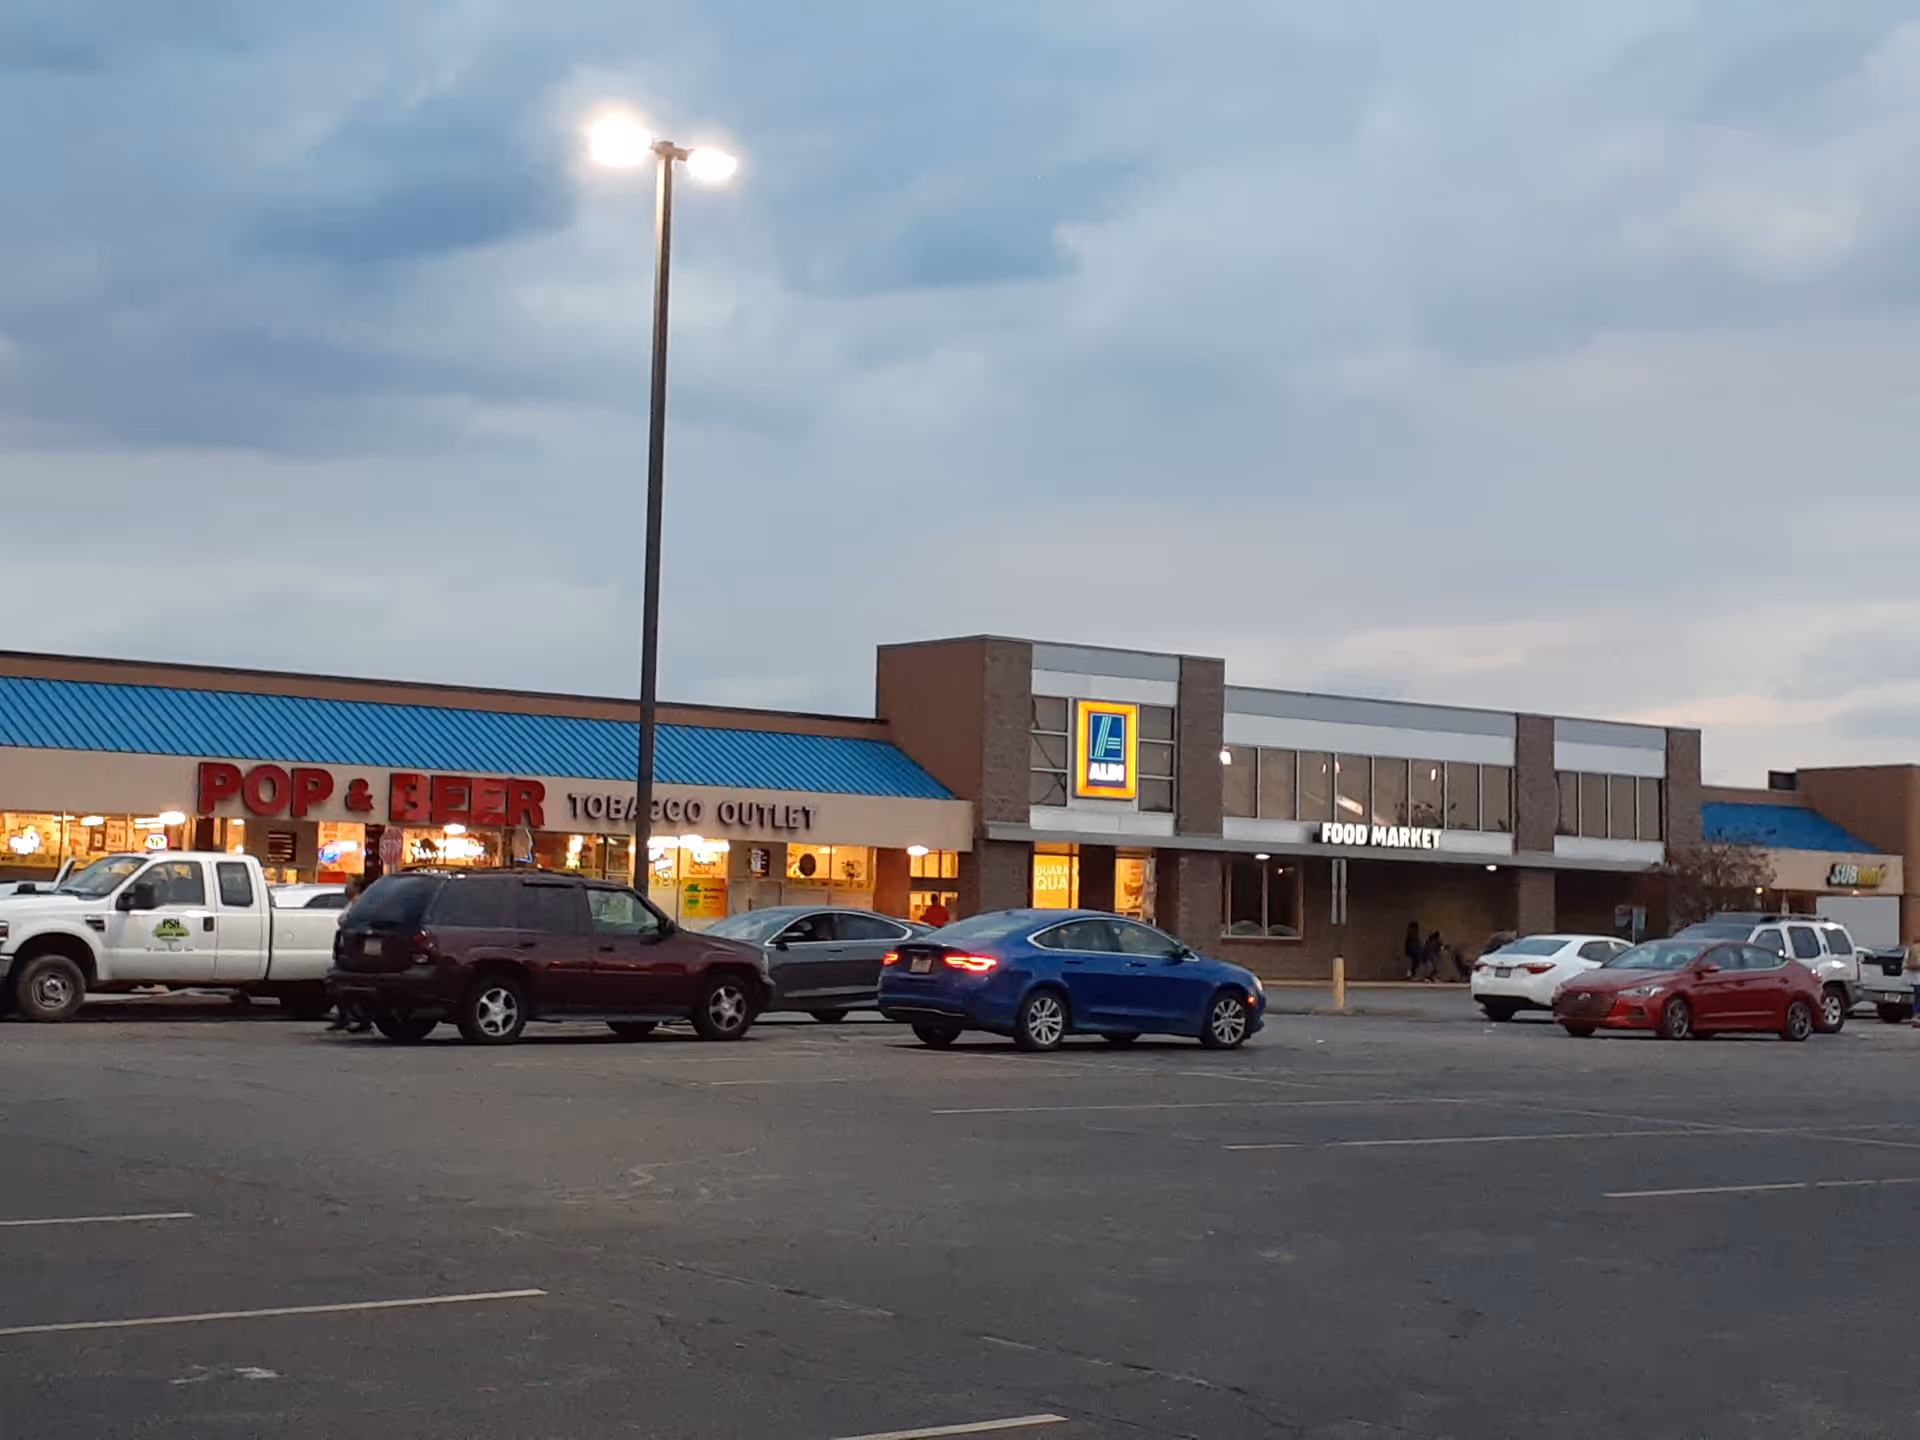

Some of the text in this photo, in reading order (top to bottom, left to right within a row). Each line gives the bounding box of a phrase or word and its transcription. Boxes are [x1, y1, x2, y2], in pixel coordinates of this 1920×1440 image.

[1089, 762, 1125, 782] ALDI
[198, 761, 546, 827] POP & BEER
[568, 793, 817, 830] TOBACCO OUTLET
[381, 838, 402, 856] STOP
[1321, 822, 1441, 849] FOOD MARKET
[1036, 876, 1079, 891] QUA
